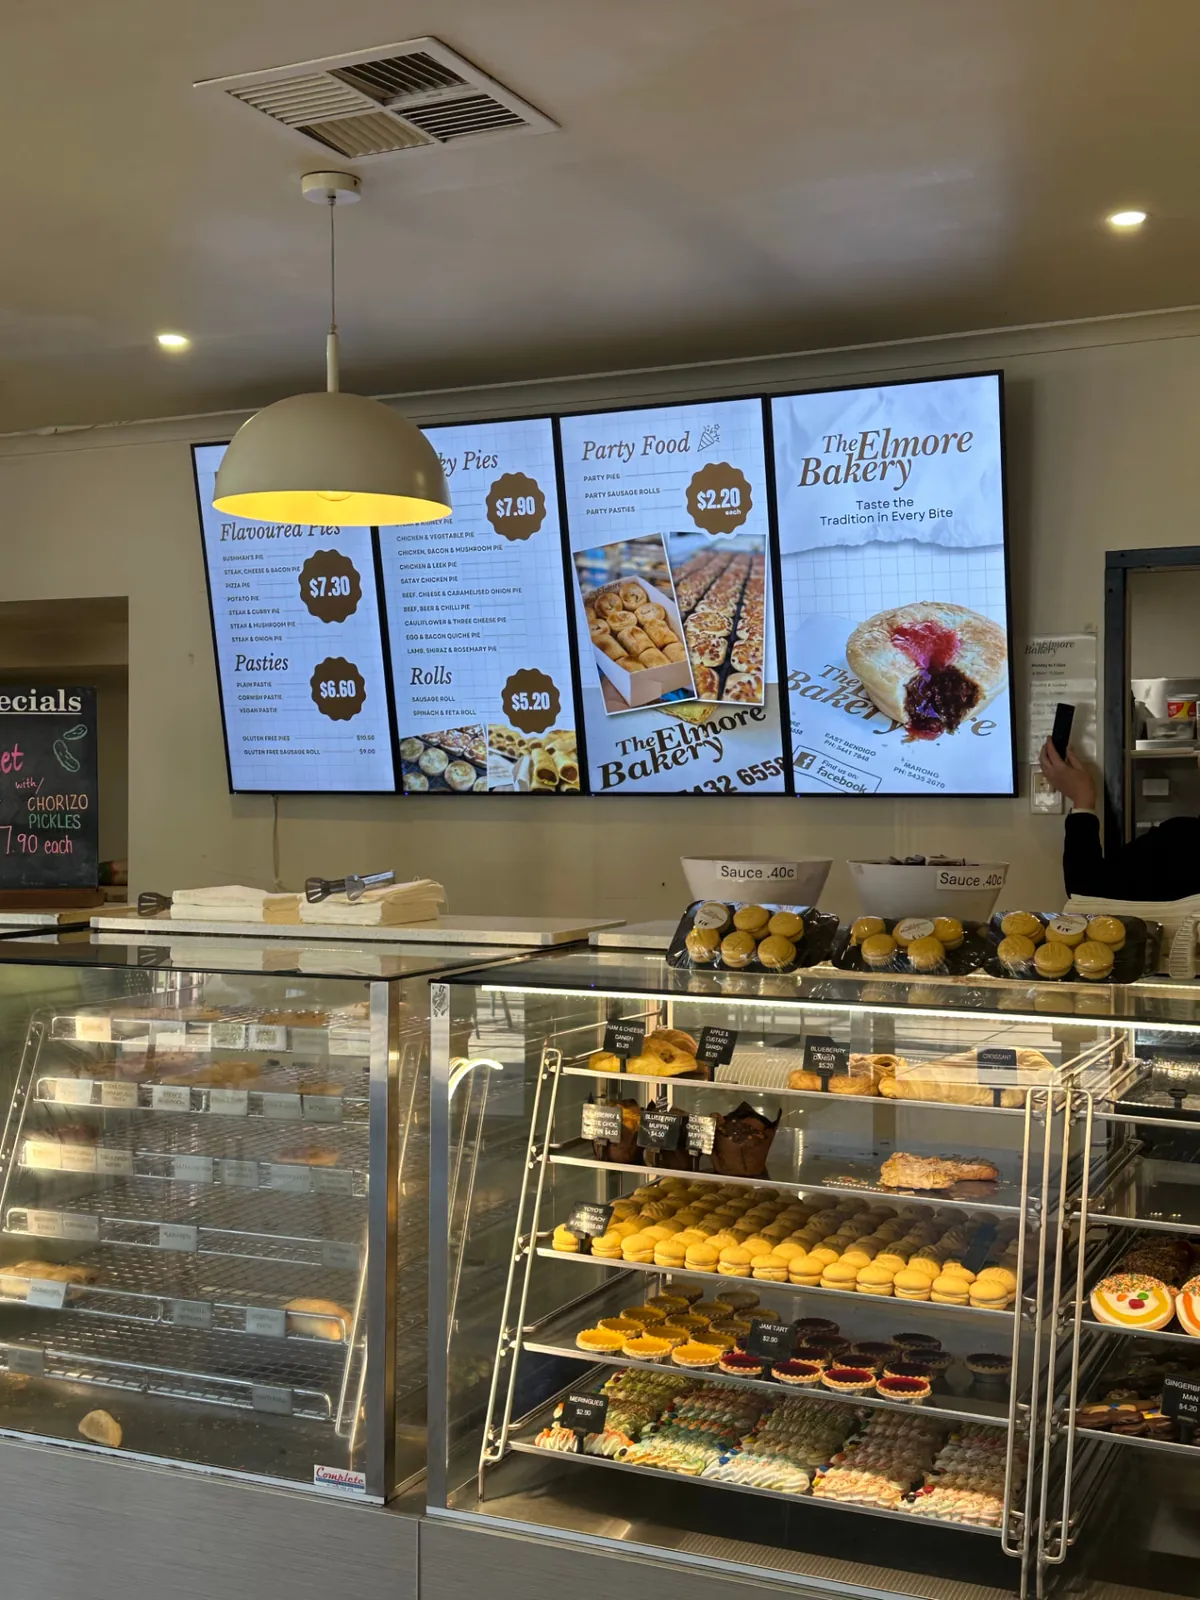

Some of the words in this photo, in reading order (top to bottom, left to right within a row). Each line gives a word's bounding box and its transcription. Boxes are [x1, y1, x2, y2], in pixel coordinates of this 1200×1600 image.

[581, 440, 635, 463] Party
[641, 430, 691, 456] Food
[822, 433, 858, 454] The
[855, 427, 974, 462] Elmore
[462, 449, 498, 471] Pies
[583, 474, 605, 482] PARTY
[797, 452, 912, 491] Bakery
[584, 491, 606, 499] PARTY
[607, 488, 638, 497] SAUSAGE
[639, 487, 660, 495] ROLLS
[697, 487, 741, 511] $2.20
[495, 495, 536, 518] $7.90
[586, 507, 608, 515] PARTY
[608, 505, 635, 514] PASTIES
[855, 499, 890, 511] Taste
[893, 497, 914, 507] the
[820, 513, 875, 526] Tradition
[877, 512, 888, 522] in
[891, 510, 925, 522] Every
[928, 508, 953, 519] Bite
[220, 522, 303, 541] Flavoured
[430, 532, 464, 541] VEGETABLE
[455, 545, 492, 553] MUSHROOM
[309, 575, 350, 598] $7.30
[420, 576, 448, 584] CHICKEN
[490, 587, 511, 595] ONION
[253, 621, 287, 629] MUSHROOM
[404, 619, 447, 627] CAULIFLOWER
[453, 617, 472, 625] THREE
[447, 632, 471, 640] QUICHE
[234, 652, 289, 672] Pasties
[409, 665, 453, 686] Rolls
[817, 664, 860, 688] The
[320, 680, 356, 699] $6.60
[0, 688, 82, 712] ecials
[511, 691, 551, 711] $5.20
[615, 735, 656, 756] The
[652, 706, 767, 754] Elmore
[824, 739, 837, 749] PH:
[824, 732, 843, 744] EAST
[843, 740, 876, 757] BENDIGO
[597, 736, 724, 790] Bakery
[821, 760, 838, 771] Find
[847, 772, 860, 780] on:
[903, 762, 940, 778] MARONG
[816, 766, 868, 793] facebook
[27, 794, 89, 811] CHORIZO
[28, 814, 81, 829] PICKLES
[44, 834, 73, 854] each
[720, 865, 763, 879] Sauce
[766, 866, 795, 879] .40c
[940, 872, 980, 886] Sauce
[982, 874, 1002, 887] .40c
[810, 1045, 847, 1054] BLUEBERRY
[818, 1062, 834, 1070] $5.20
[644, 1113, 677, 1123] BLUEBERRY
[650, 1130, 665, 1138] $4.50
[759, 1323, 772, 1331] JAM
[773, 1325, 789, 1333] TART
[569, 1395, 604, 1407] MERINGUES
[1182, 1393, 1199, 1402] MAN
